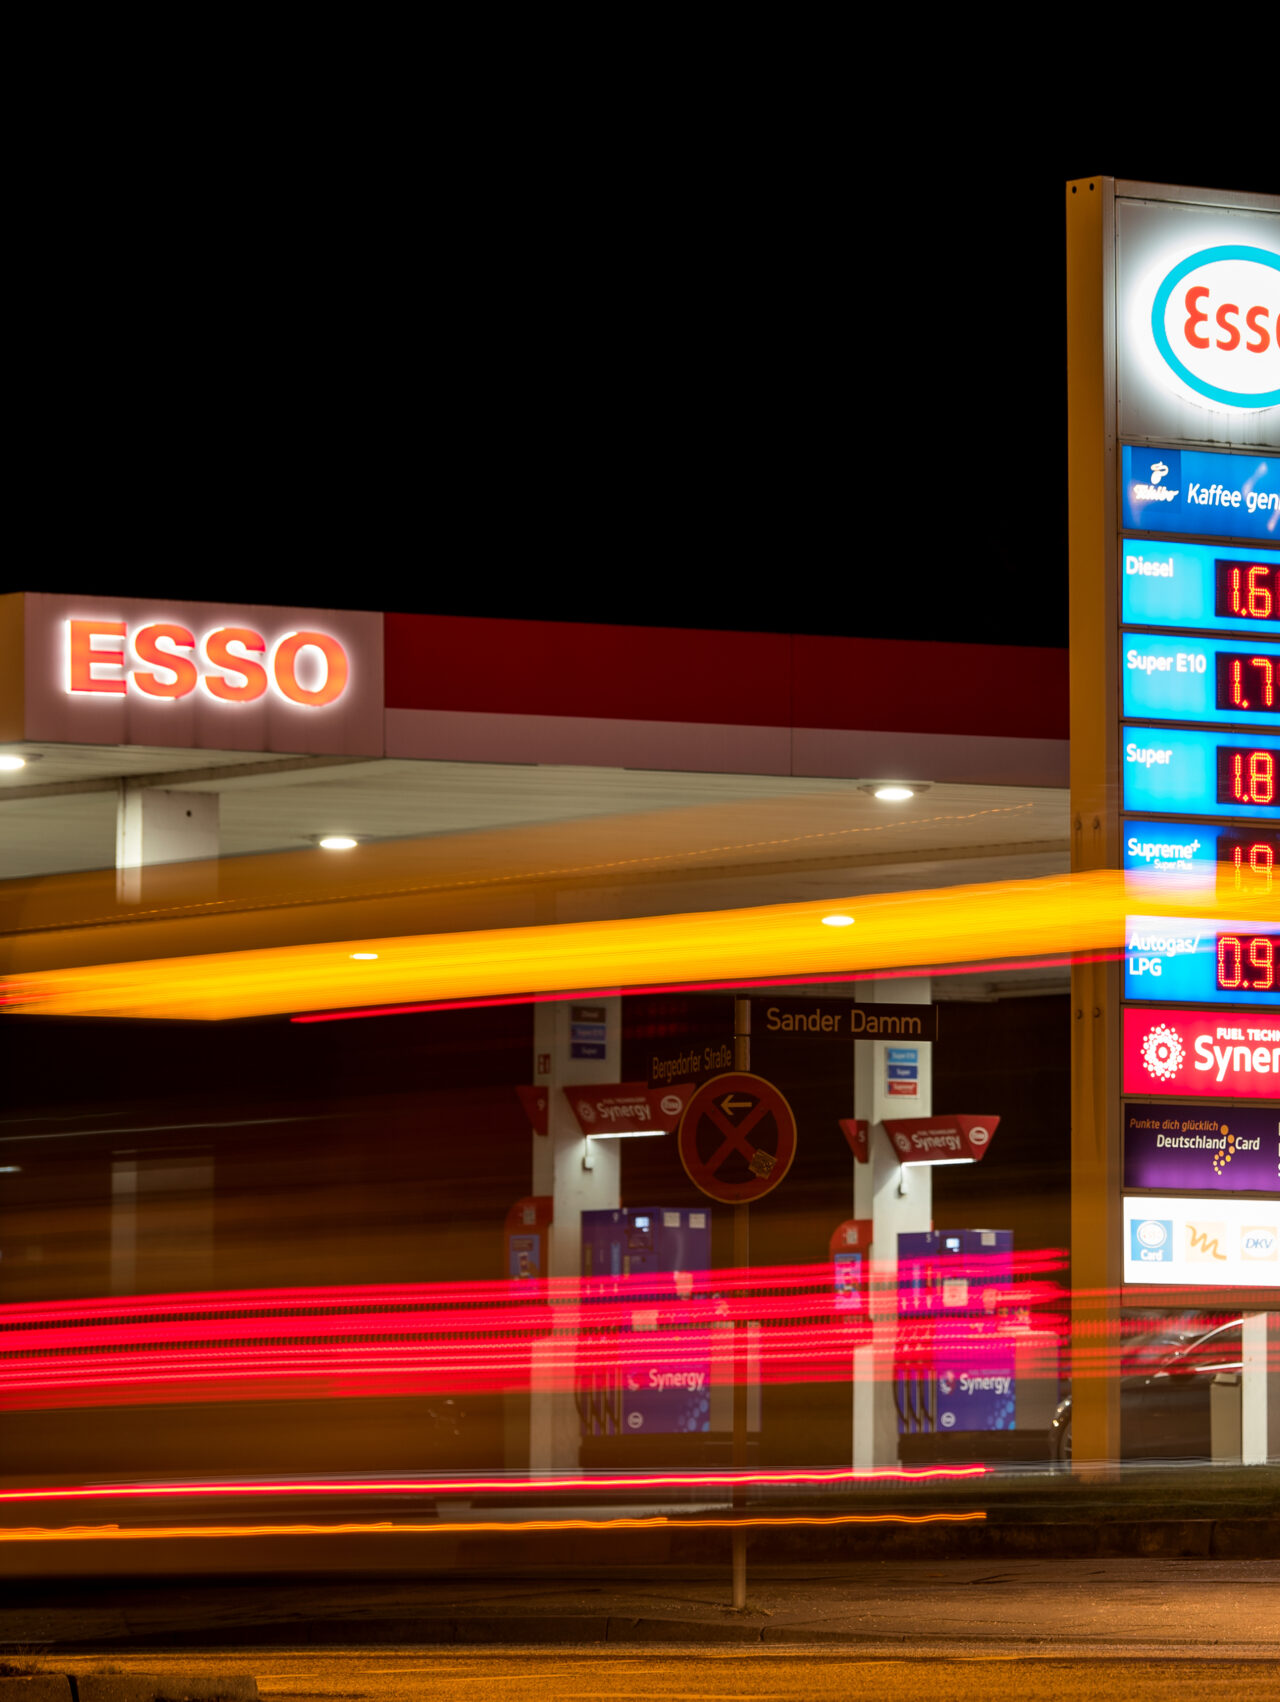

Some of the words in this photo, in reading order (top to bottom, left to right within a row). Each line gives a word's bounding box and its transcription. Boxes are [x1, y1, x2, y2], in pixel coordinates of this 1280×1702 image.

[1187, 483, 1242, 507] Kaffee
[1126, 556, 1174, 578] Diesel
[66, 619, 349, 707] ESSO
[1127, 650, 1173, 675] Super
[1176, 654, 1206, 673] E10
[1126, 744, 1172, 768] Super
[1128, 933, 1201, 956] Autogas/
[1128, 958, 1162, 976] LPG
[766, 1007, 841, 1033] Sander
[850, 1009, 922, 1035] Damm
[1217, 1028, 1244, 1040] FUEL
[652, 1050, 701, 1083] Bergedorfer
[704, 1044, 732, 1071] Straße
[596, 1101, 651, 1122] Synergy
[1130, 1118, 1160, 1129] Punkte
[1162, 1119, 1180, 1130] dich
[1181, 1120, 1219, 1132] glücklich
[912, 1133, 961, 1153] Synergy
[1156, 1134, 1227, 1150] Deutschland
[1235, 1137, 1261, 1151] Card
[1245, 1238, 1273, 1250] DKV
[649, 1369, 705, 1392] Synergy
[960, 1374, 1011, 1395] Synergy
